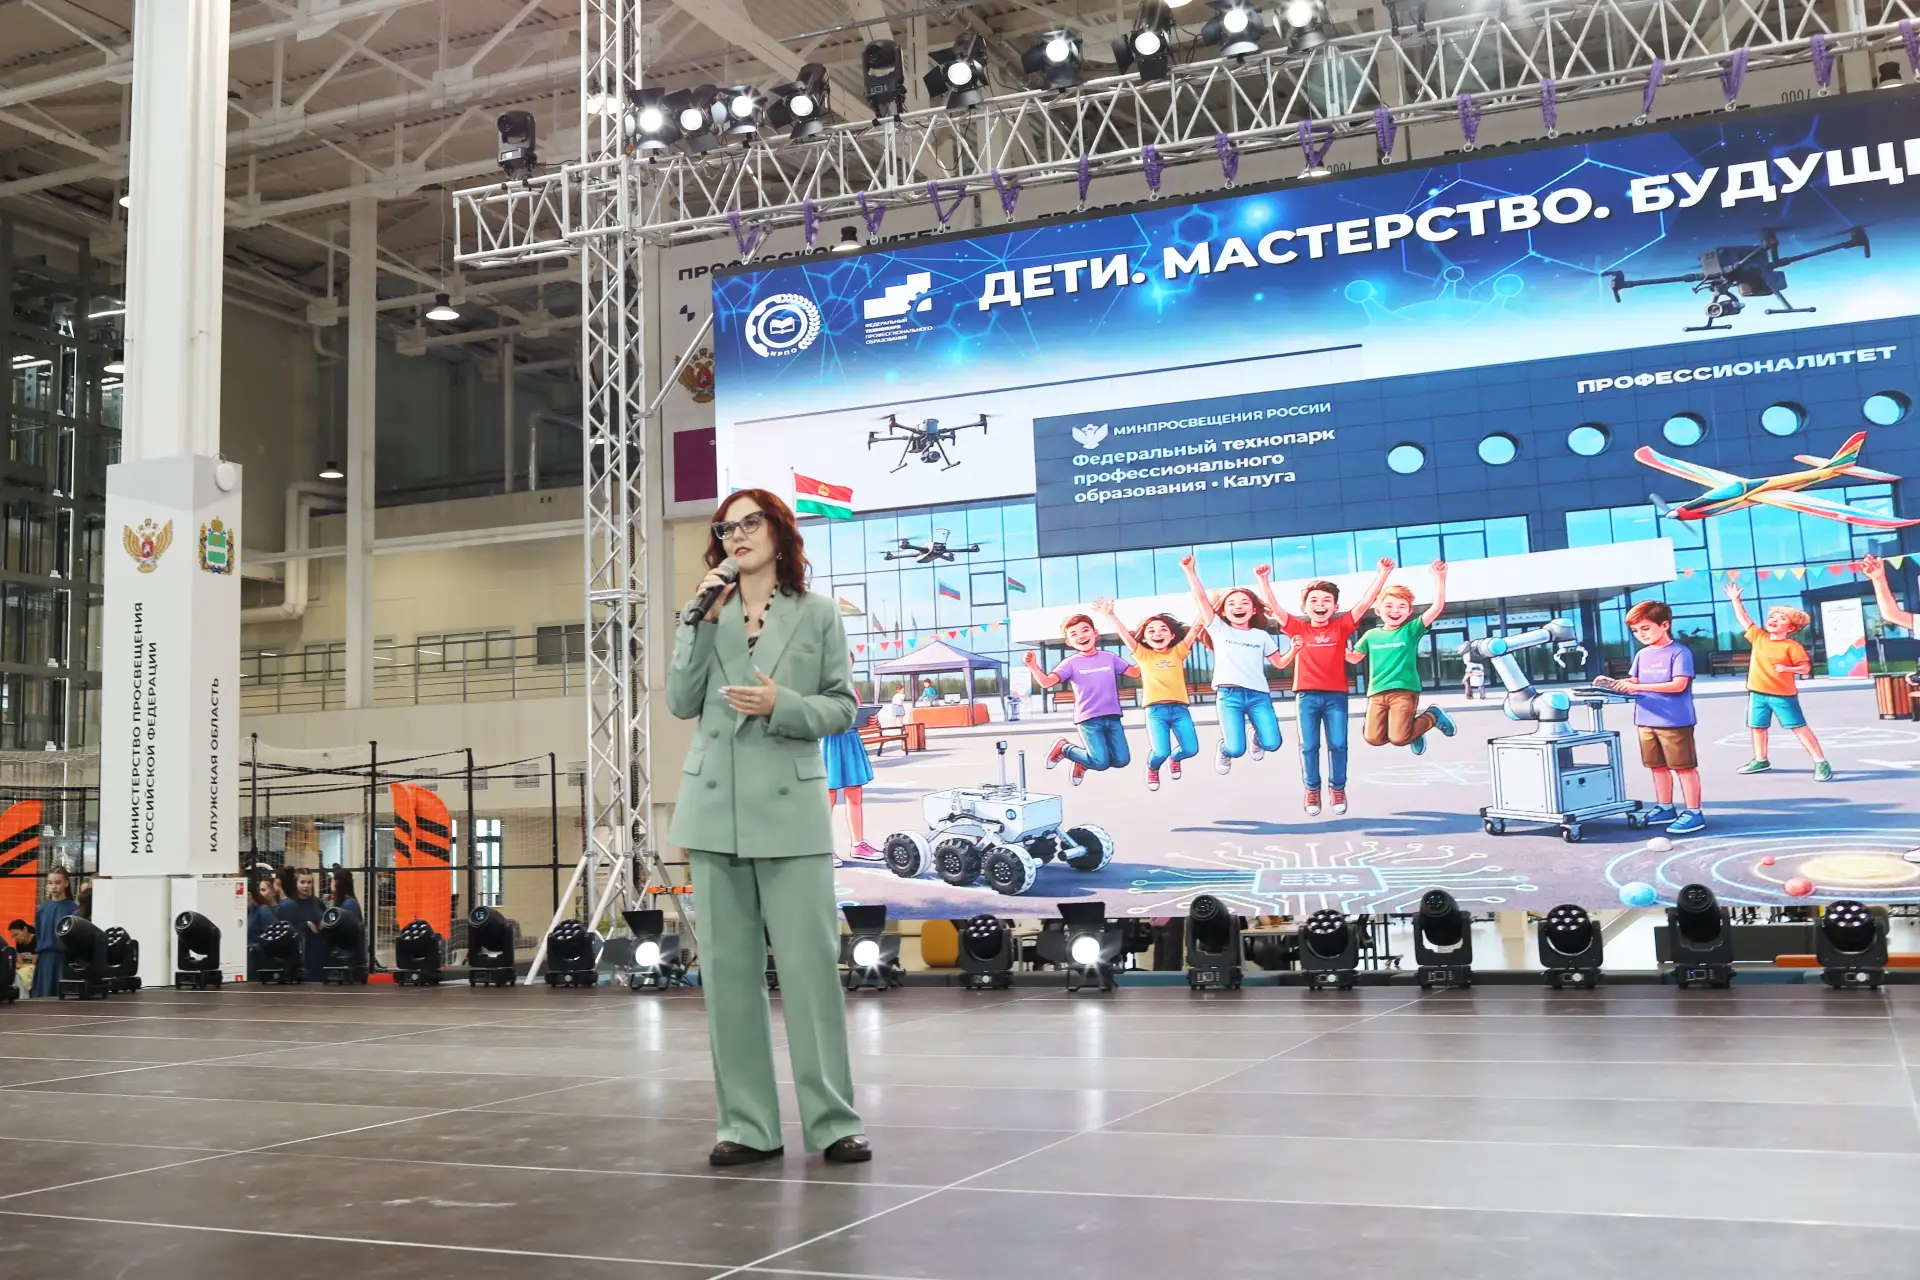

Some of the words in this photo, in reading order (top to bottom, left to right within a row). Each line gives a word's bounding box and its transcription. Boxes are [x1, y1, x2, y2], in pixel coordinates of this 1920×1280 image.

[979, 254, 1146, 311] ДЕТИ.
[1164, 188, 1609, 279] МАСТЕРСТВО.
[865, 317, 908, 328] ФЕДЕРАЛЬНЫЙ
[865, 325, 902, 333] ТЕХНОПАРК
[865, 326, 933, 339] ПРОФЕССИОНАЛЬНОГО
[865, 335, 908, 345] ОБРАЗОВАНИЯ
[770, 347, 798, 357] ИРПО
[1577, 346, 1897, 393] ПРОФЕССИОНАЛИТЕТ
[1113, 410, 1263, 436] МИНПРОСВЕЩЕНИЯ
[1267, 402, 1331, 418] РОССИИ
[1073, 439, 1217, 470] Федеральный
[1222, 428, 1336, 452] технопарк
[1074, 454, 1285, 486] профессионального
[1074, 480, 1206, 504] образования
[1224, 471, 1296, 489] Калуга
[133, 602, 144, 722] ПРОСВЕЩЕНИЯ
[147, 642, 158, 741] ФЕДЕРАЦИИ
[210, 677, 219, 751] ОБЛАСТЬ
[131, 726, 142, 854] МИНИСТЕРСТВО
[144, 745, 156, 854] РОССИЙСКОЙ
[210, 755, 219, 853] КАЛУЖСКАЯ
